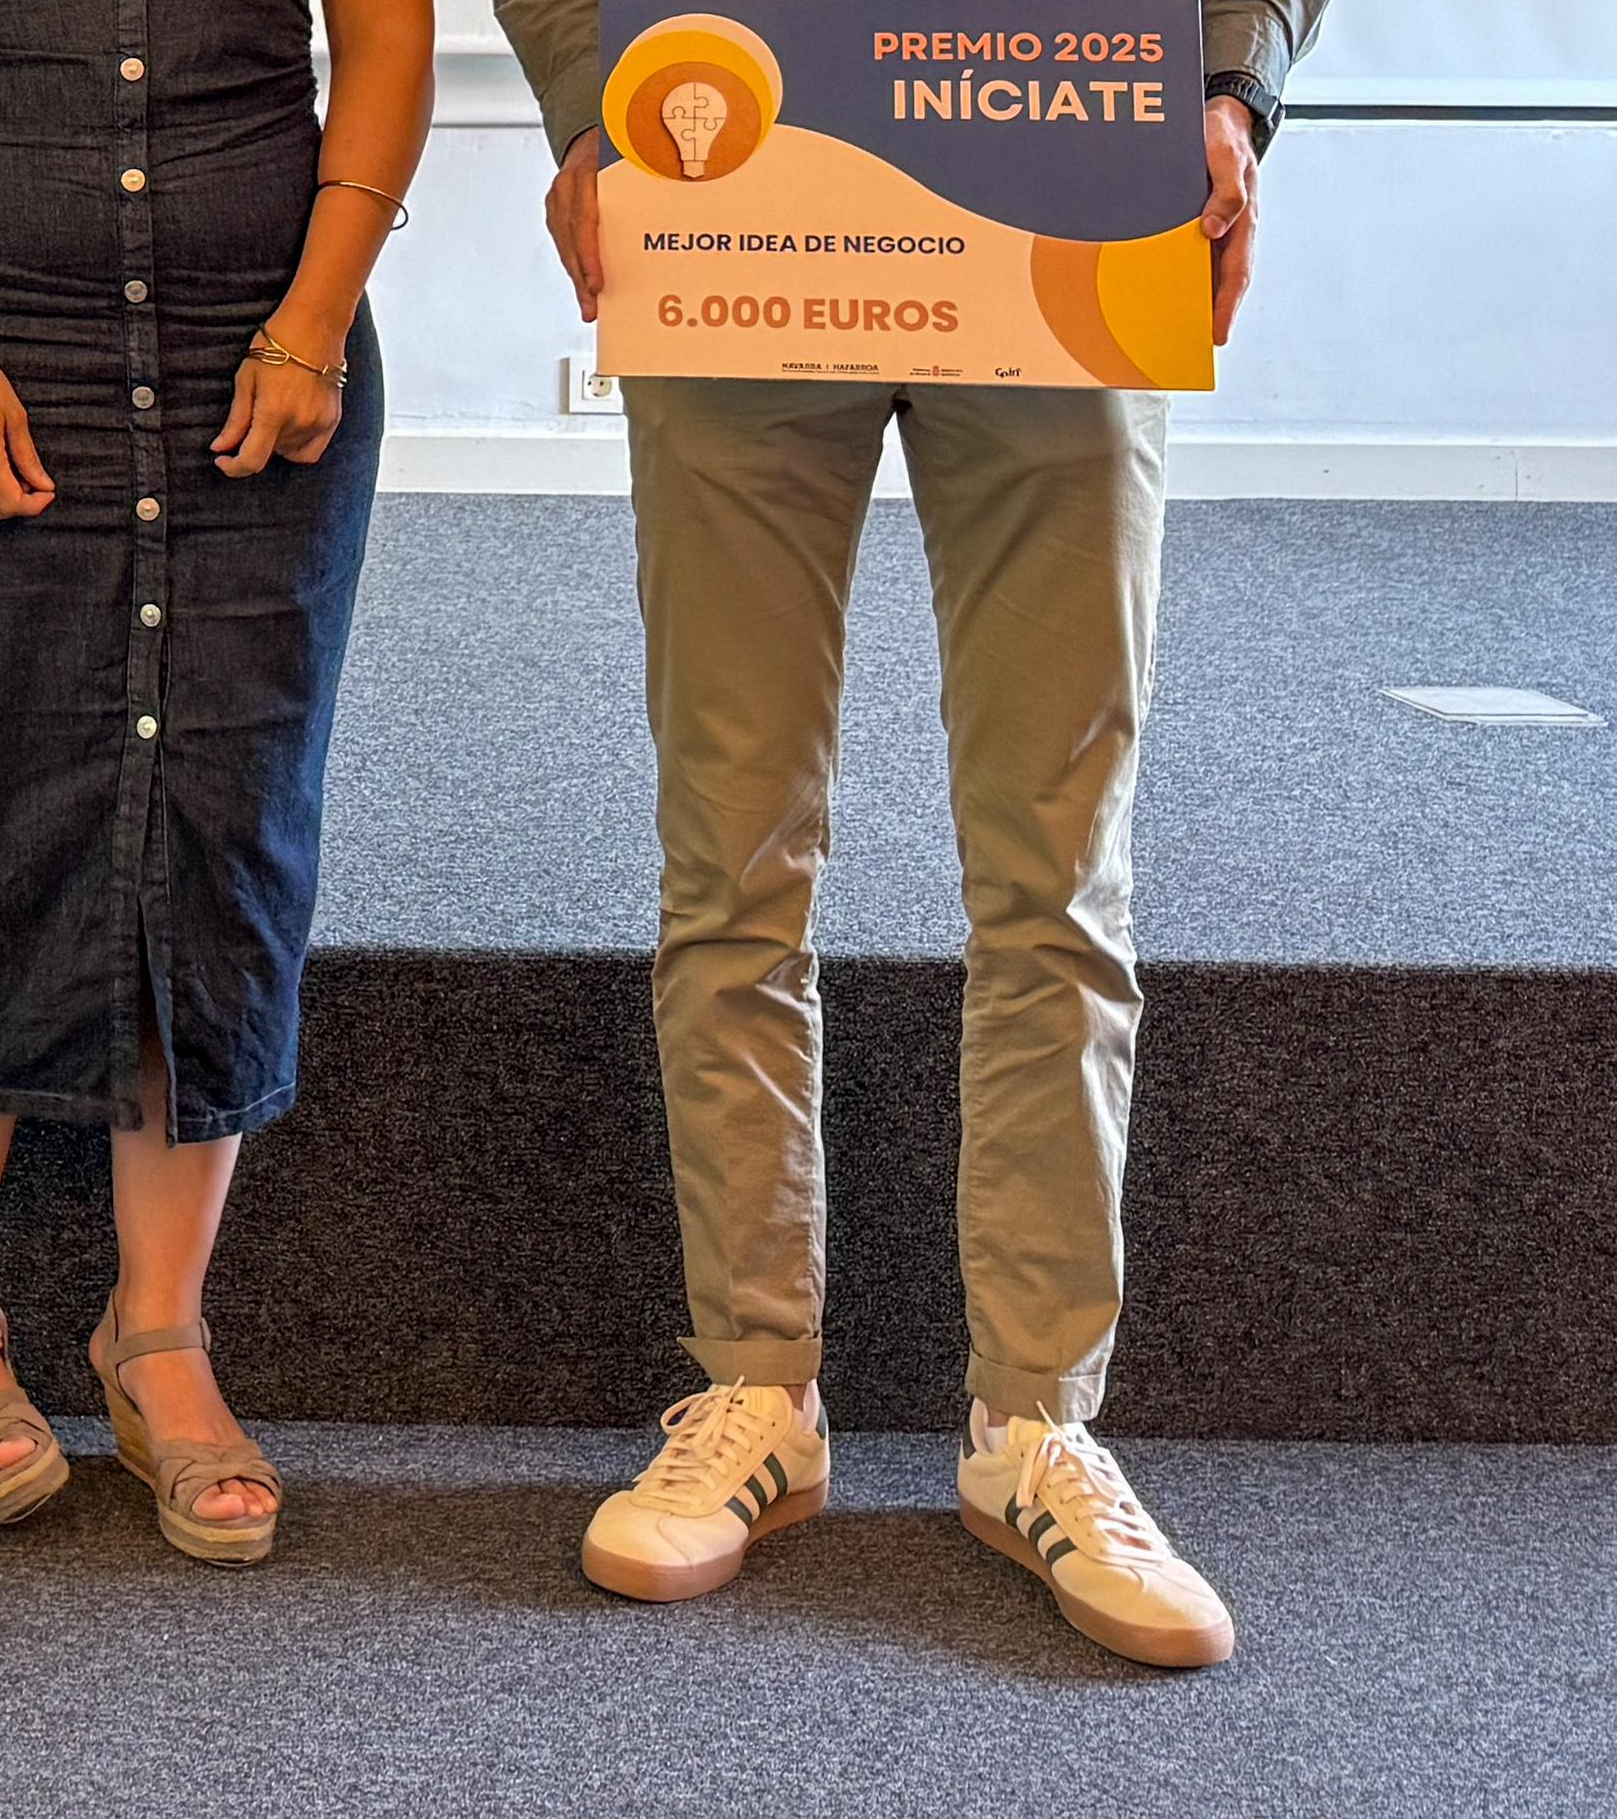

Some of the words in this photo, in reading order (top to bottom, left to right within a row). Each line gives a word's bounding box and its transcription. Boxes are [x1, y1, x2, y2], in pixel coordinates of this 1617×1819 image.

[874, 32, 1043, 62] PREMIO
[1054, 32, 1164, 63] 2025
[893, 69, 1165, 122] INÍCIATE
[644, 232, 732, 252] MEJOR
[739, 234, 798, 253] IDEA
[804, 235, 837, 253] DE
[843, 235, 966, 255] NEGOCIO
[658, 294, 791, 329] 6.000
[803, 298, 959, 333] EUROS
